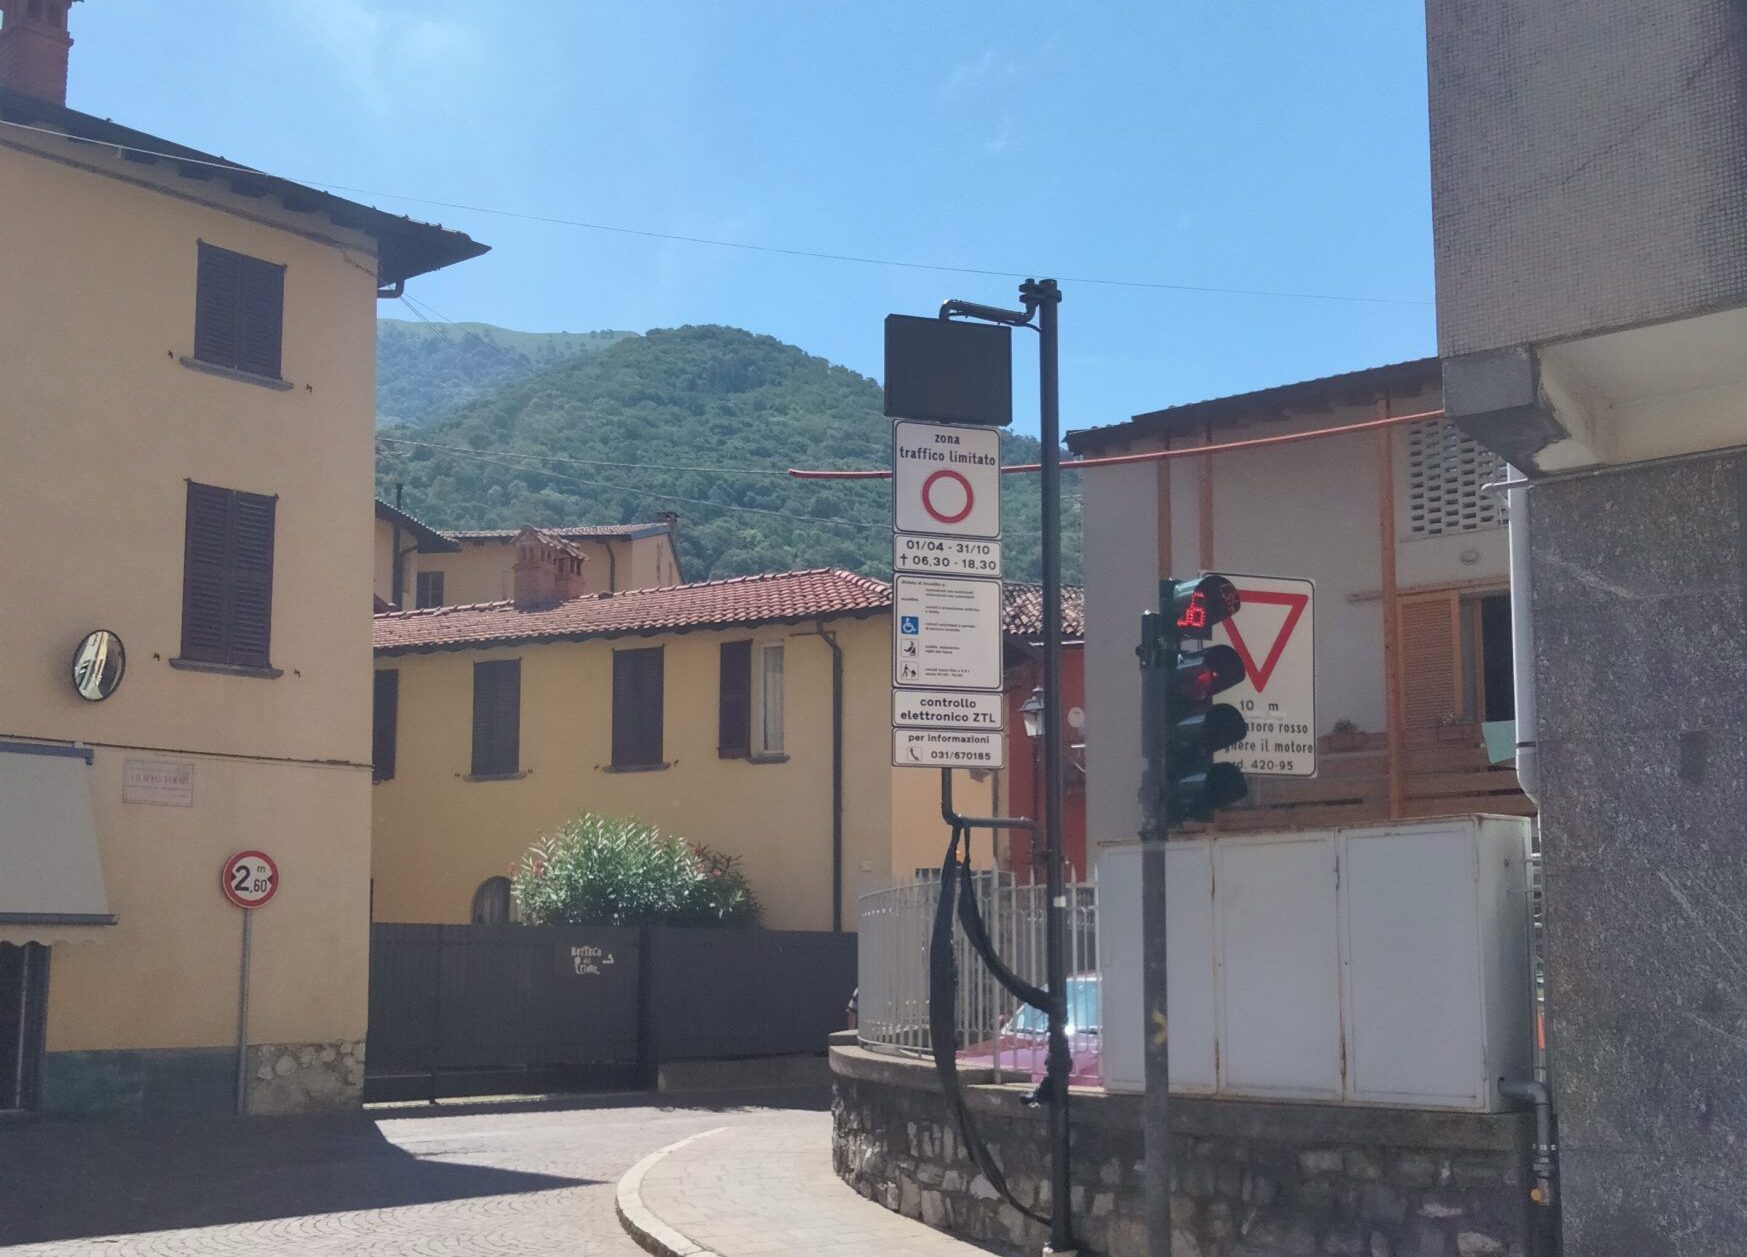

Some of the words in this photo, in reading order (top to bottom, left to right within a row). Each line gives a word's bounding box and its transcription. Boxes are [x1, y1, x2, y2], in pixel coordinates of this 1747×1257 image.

[935, 434, 960, 444] zona
[899, 447, 945, 461] traffico
[949, 450, 996, 466] limitato
[906, 540, 944, 551] 01/04
[956, 543, 990, 555] 31/10
[920, 698, 976, 708] controllo
[1239, 700, 1254, 710] 10
[1268, 703, 1279, 711] m
[900, 711, 969, 722] elettronico
[972, 713, 996, 723] ZTL
[1279, 724, 1308, 734] rosso
[908, 734, 925, 742] per
[927, 734, 990, 744] informazioni
[1260, 739, 1269, 752] il
[1274, 740, 1313, 754] motore
[930, 751, 991, 760] 031/670185
[234, 865, 267, 893] 2,60
